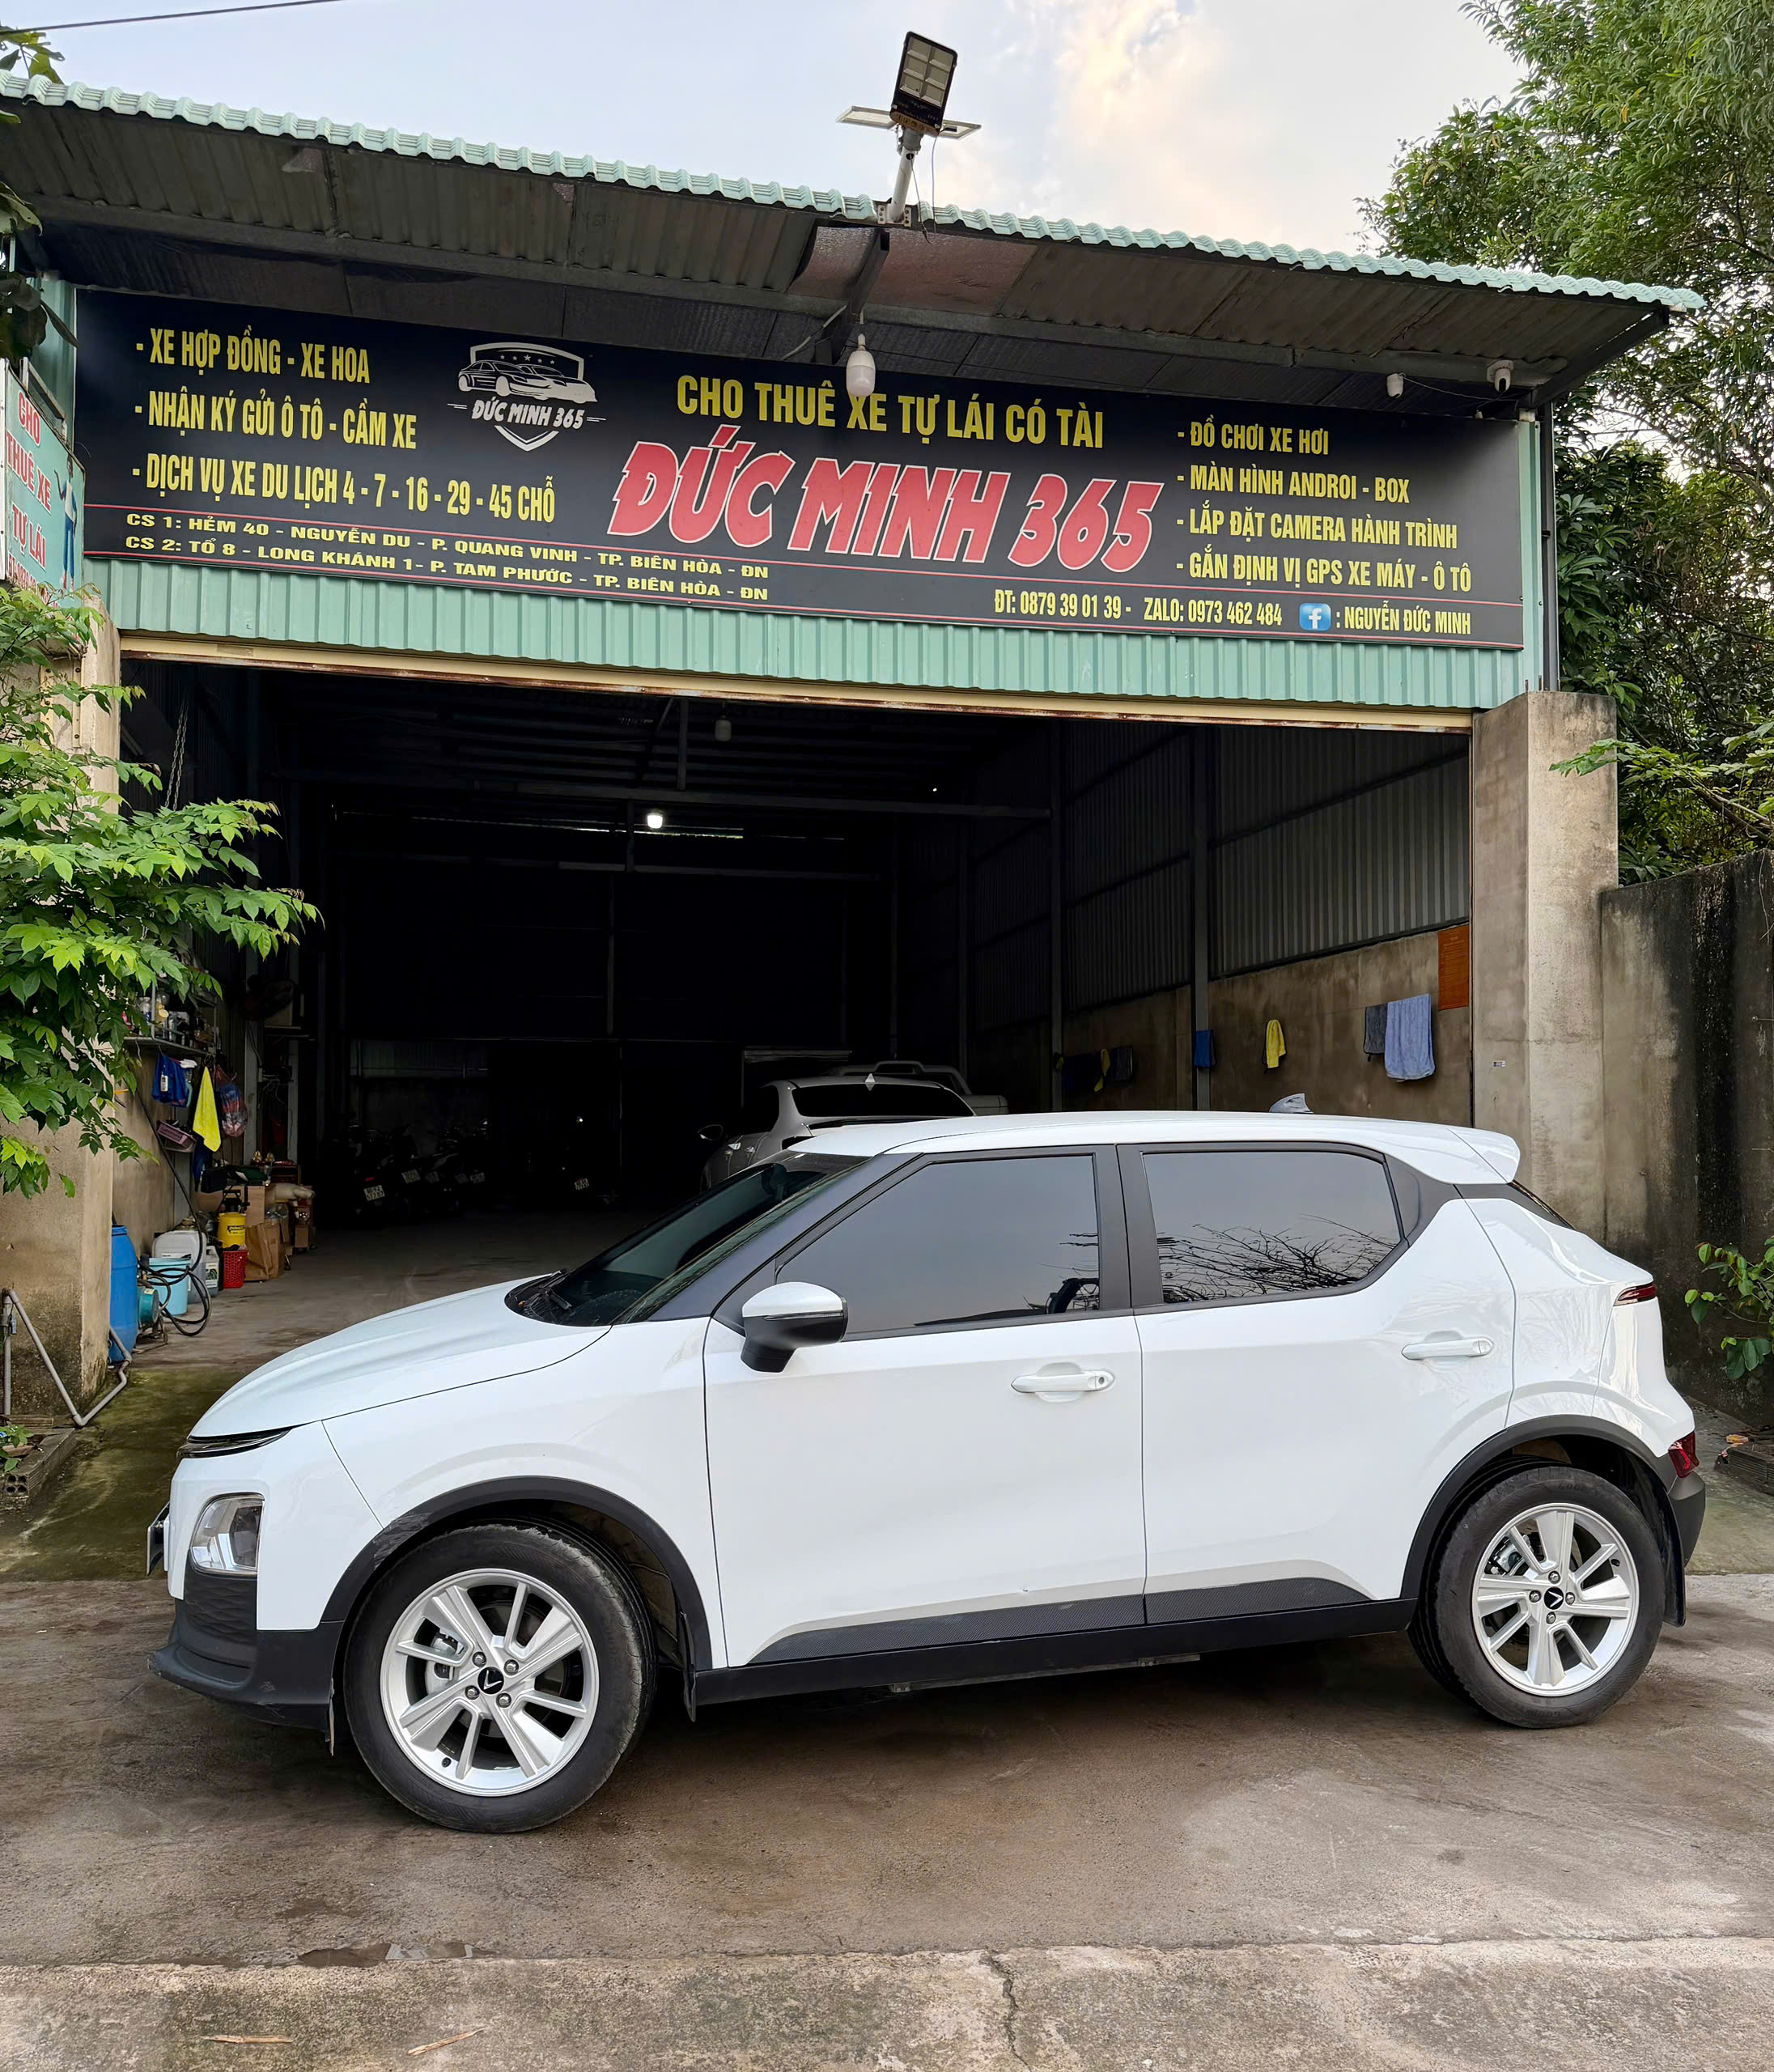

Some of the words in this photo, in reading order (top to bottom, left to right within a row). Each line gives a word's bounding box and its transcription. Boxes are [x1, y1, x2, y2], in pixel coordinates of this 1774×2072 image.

[151, 329, 175, 365] XE
[182, 329, 221, 376] HỢP
[227, 325, 282, 376] ĐỒNG
[300, 343, 325, 379] XE
[332, 346, 370, 384] HOA
[18, 389, 40, 446] CHO
[149, 386, 206, 436] NHẬN
[211, 390, 237, 433] KÝ
[243, 388, 275, 437] GỬI
[281, 396, 295, 439] Ô
[300, 398, 324, 441] TÔ
[343, 398, 387, 447] CẦM
[393, 414, 418, 450] XE
[471, 396, 507, 422] ĐỨC
[507, 403, 552, 427] MINH
[553, 407, 585, 430] 365
[677, 374, 743, 419] CHO
[754, 380, 836, 427] THUÊ
[847, 393, 887, 431] XE
[898, 393, 941, 444] TỰ
[946, 394, 995, 441] LÁI
[1005, 398, 1047, 445] CÓ
[1057, 402, 1104, 448] TÀI
[1190, 415, 1216, 448] ĐỒ
[1221, 423, 1263, 451] CHƠI
[1270, 427, 1292, 453] XE
[1298, 428, 1329, 456] HƠI
[6, 430, 35, 495] THUÊ
[36, 467, 52, 515] XE
[146, 453, 194, 498] DỊCH
[200, 458, 226, 503] VỤ
[231, 460, 257, 497] XE
[261, 463, 289, 499] DU
[295, 465, 337, 509] LỊCH
[343, 471, 355, 506] 4
[375, 473, 387, 507] 7
[406, 478, 428, 512] 16
[447, 479, 471, 516] 29
[489, 485, 512, 519] 45
[518, 477, 556, 524] CHỖ
[607, 424, 796, 547] ĐỨC
[787, 457, 1012, 563] MINH
[1008, 473, 1165, 572] 365
[1190, 462, 1233, 492] MÀN
[1239, 464, 1284, 495] HÌNH
[1288, 472, 1357, 500] ANDROI
[1375, 478, 1410, 504] BOX
[12, 502, 28, 555] TỰ
[28, 524, 46, 571] LÁI
[126, 513, 155, 527] CS
[163, 516, 181, 529] 1:
[189, 516, 236, 533] HẺM
[244, 523, 269, 536] 40
[291, 525, 376, 545] NGUYỄN
[383, 533, 410, 547] DU
[432, 538, 448, 551] P.
[455, 541, 524, 558] QUANG
[529, 546, 577, 563] VINH
[597, 552, 624, 567] TP.
[630, 555, 677, 571] BIÊN
[682, 558, 722, 575] HÒA
[741, 565, 768, 579] ĐN
[1190, 499, 1224, 535] LẮP
[1230, 506, 1264, 541] ĐẶT
[1270, 512, 1346, 541] CAMERA
[1352, 513, 1399, 545] HÀNH
[1405, 518, 1458, 549] TRÌNH
[125, 536, 155, 550] CS
[162, 539, 181, 552] 2:
[223, 543, 236, 555] 8
[258, 546, 315, 562] LONG
[322, 550, 395, 569] KHÁNH
[431, 560, 447, 573] P.
[453, 562, 496, 577] TAM
[503, 566, 573, 584] PHƯỚC
[593, 575, 621, 588] TP.
[627, 577, 674, 593] BIÊN
[681, 580, 721, 597] HÒA
[740, 587, 768, 601] ĐN
[1190, 544, 1228, 580] GẮN
[1233, 554, 1278, 586] ĐỊNH
[1284, 557, 1301, 588] VỊ
[1306, 558, 1343, 585] GPS
[1348, 560, 1370, 586] XE
[1377, 558, 1415, 588] MÁY
[1433, 561, 1445, 591] Ô
[1450, 563, 1471, 592] TÔ
[995, 589, 1016, 614] ĐT:
[1020, 591, 1055, 615] 0879
[1059, 593, 1078, 617] 39
[1082, 595, 1098, 618] 01
[1103, 595, 1122, 619] 39
[1144, 597, 1184, 622] ZALO:
[1188, 599, 1223, 624] 0973
[1226, 601, 1253, 625] 462
[1256, 602, 1283, 626] 484
[1344, 600, 1400, 631] NGUYỄN
[1403, 605, 1431, 633] ĐỨC
[1435, 612, 1471, 635] MINH
